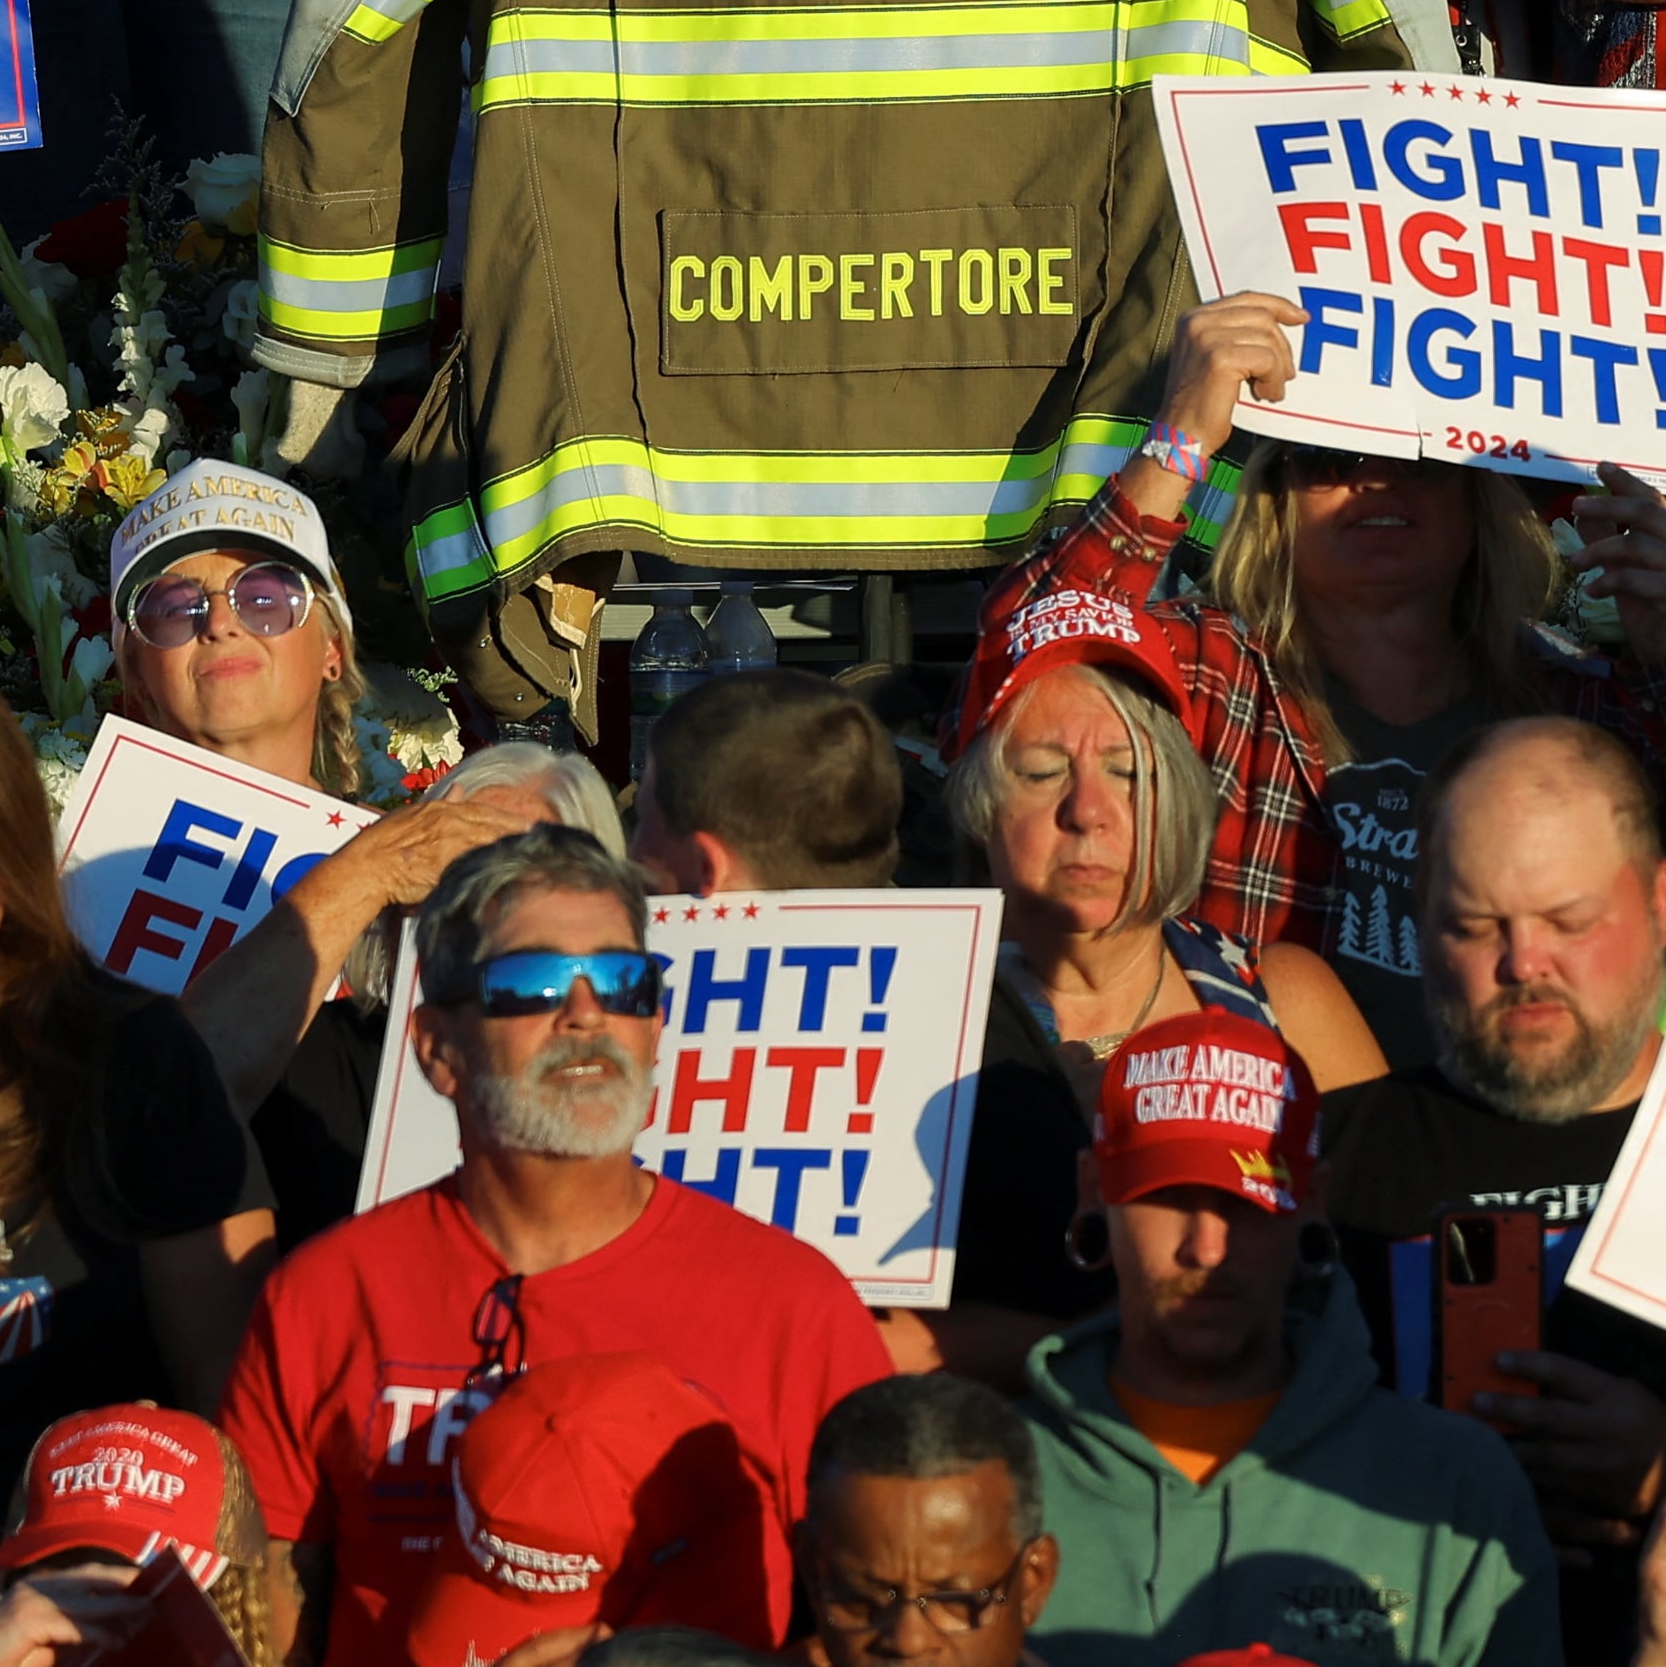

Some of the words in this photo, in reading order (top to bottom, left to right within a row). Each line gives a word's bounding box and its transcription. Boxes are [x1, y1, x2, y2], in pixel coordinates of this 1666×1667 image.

[1256, 117, 1663, 235] FIGHT!
[668, 247, 1074, 323] COMPERTORE
[1445, 425, 1531, 464] 2024
[120, 490, 181, 542] MAKE
[185, 475, 307, 517] AMERICA
[212, 508, 294, 541] AGAIN
[1006, 589, 1135, 631] JESUS
[1006, 618, 1142, 667] TRUMP
[1376, 796, 1410, 812] 1872
[1122, 1045, 1192, 1091] MAKE
[1193, 1051, 1296, 1104] AMERICA
[1135, 1083, 1208, 1127] GREAT
[1209, 1088, 1284, 1134] AGAIN
[92, 1446, 144, 1465] 2020
[50, 1461, 186, 1502] TRUMP
